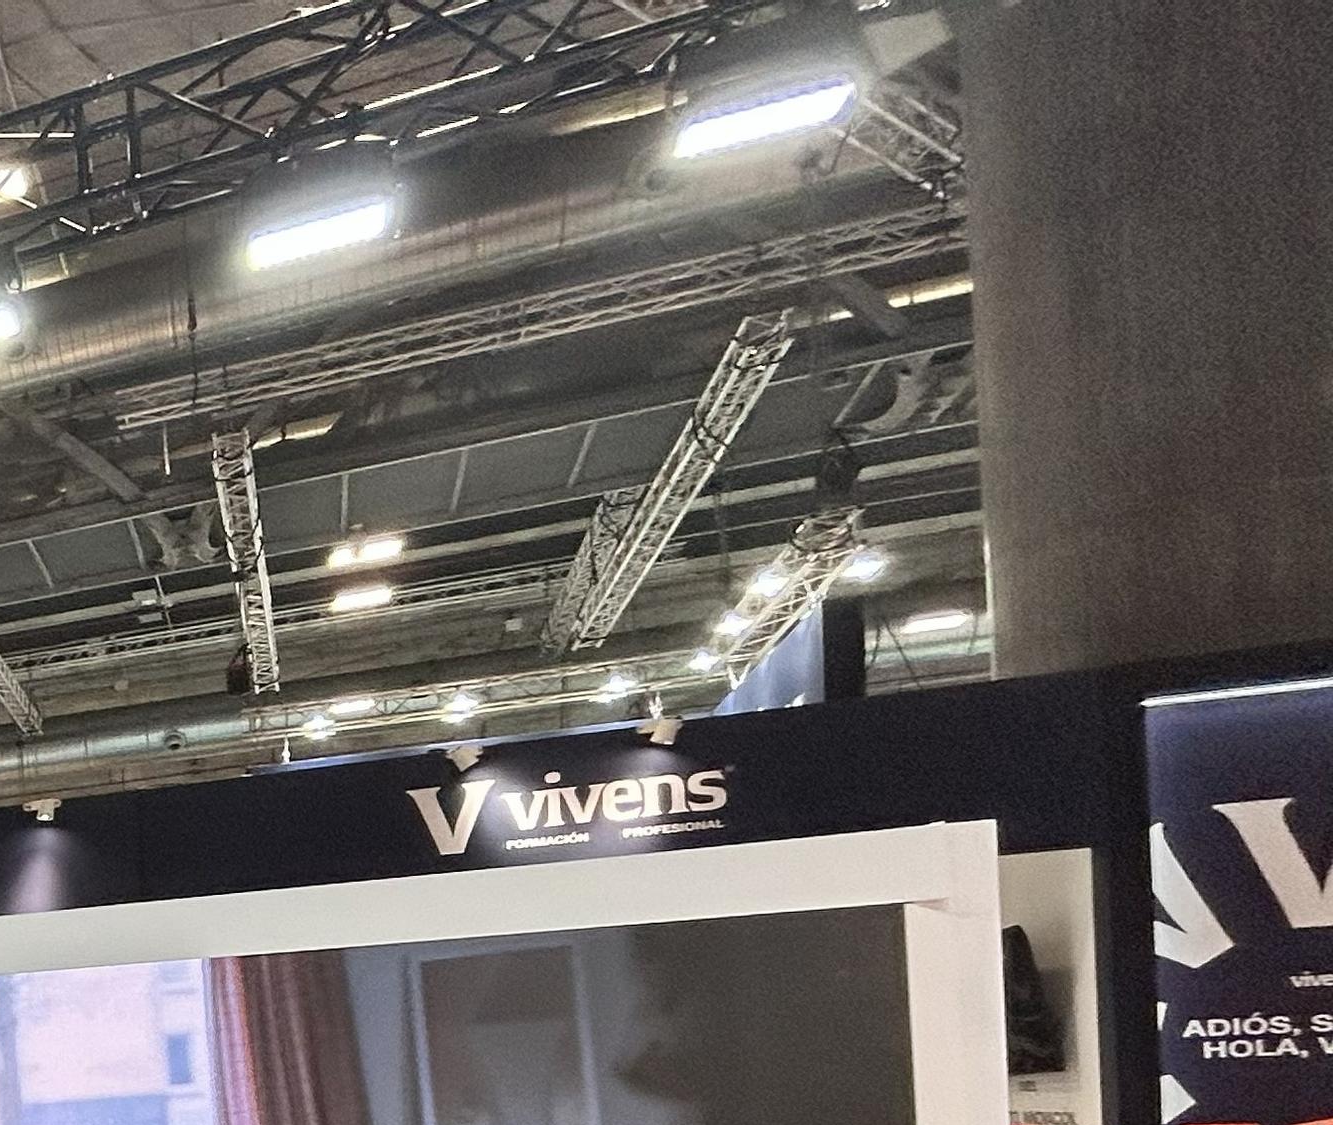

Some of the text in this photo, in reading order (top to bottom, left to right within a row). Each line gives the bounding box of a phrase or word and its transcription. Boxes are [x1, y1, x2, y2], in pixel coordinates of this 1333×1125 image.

[500, 769, 728, 831] vivens
[506, 819, 726, 850] FORMACIÓN PROFESIONAL
[1182, 1011, 1303, 1038] ADIÓS,
[1202, 1037, 1310, 1059] HOLA,
